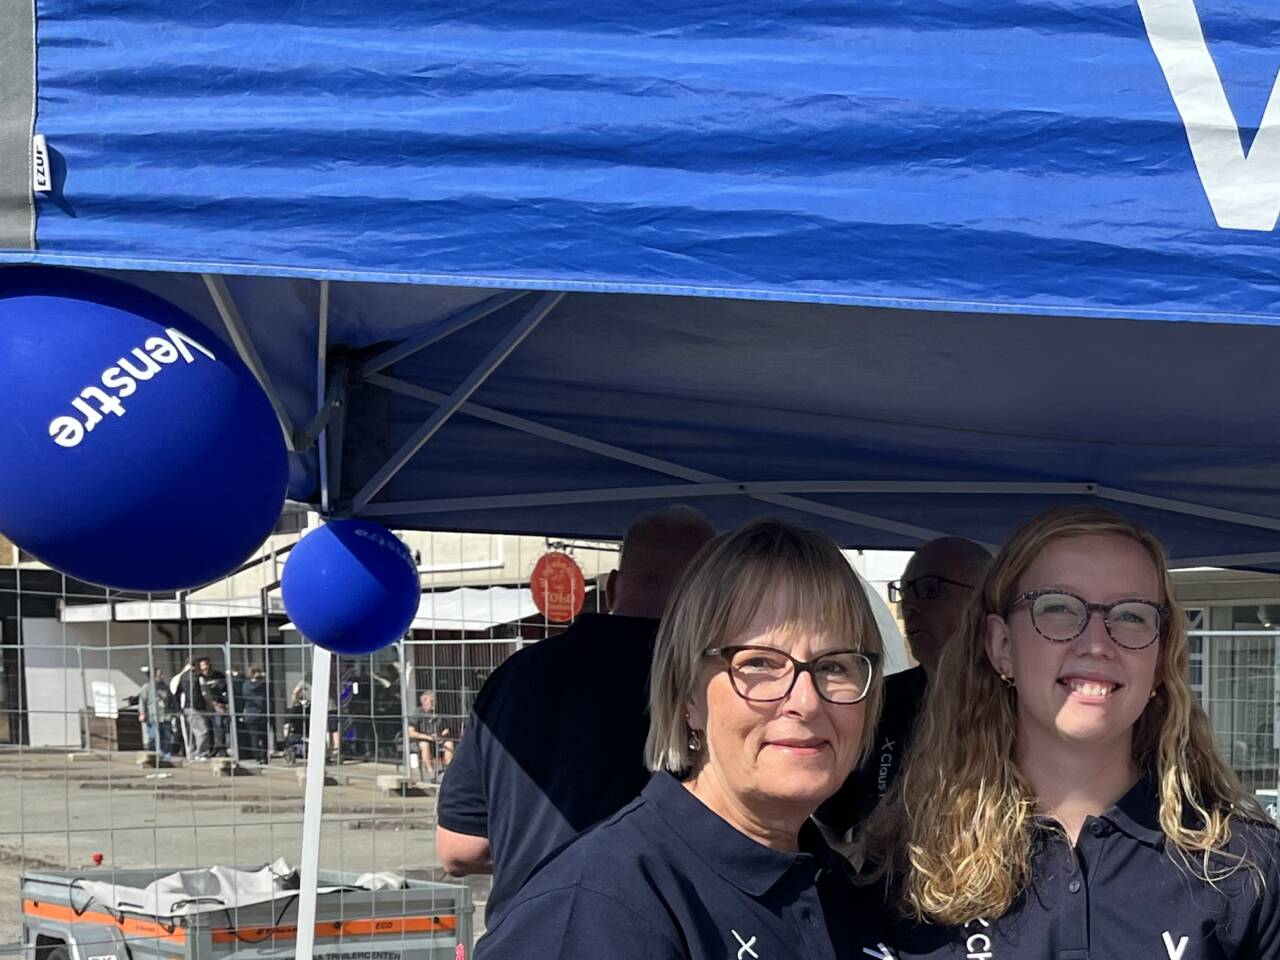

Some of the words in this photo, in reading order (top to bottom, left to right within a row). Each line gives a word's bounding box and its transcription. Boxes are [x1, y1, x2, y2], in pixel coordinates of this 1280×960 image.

[49, 328, 216, 447] Venstre
[877, 753, 893, 791] Claus
[731, 929, 758, 960] X
